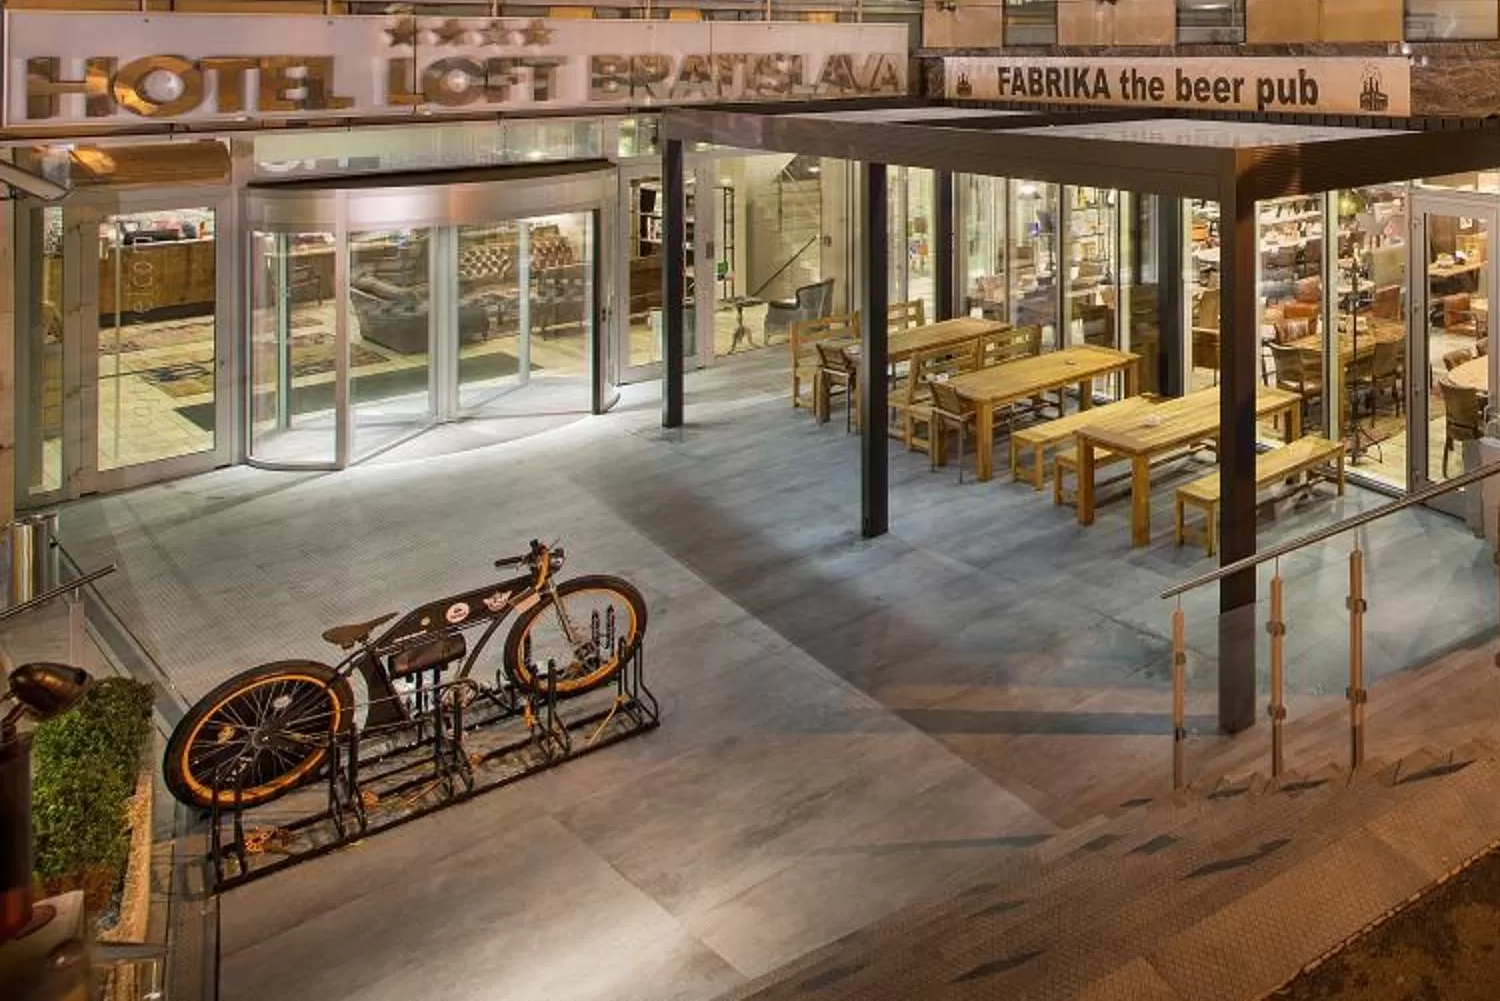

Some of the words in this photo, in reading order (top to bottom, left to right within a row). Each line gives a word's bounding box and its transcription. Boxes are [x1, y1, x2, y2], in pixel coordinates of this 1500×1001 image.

[20, 55, 355, 120] HOTEL
[384, 55, 567, 107] LOFT
[590, 53, 902, 101] BRATISLAVA
[997, 65, 1111, 100] FABRIKA
[1119, 69, 1165, 102] the
[1175, 68, 1245, 105] beer
[1256, 68, 1319, 111] pub
